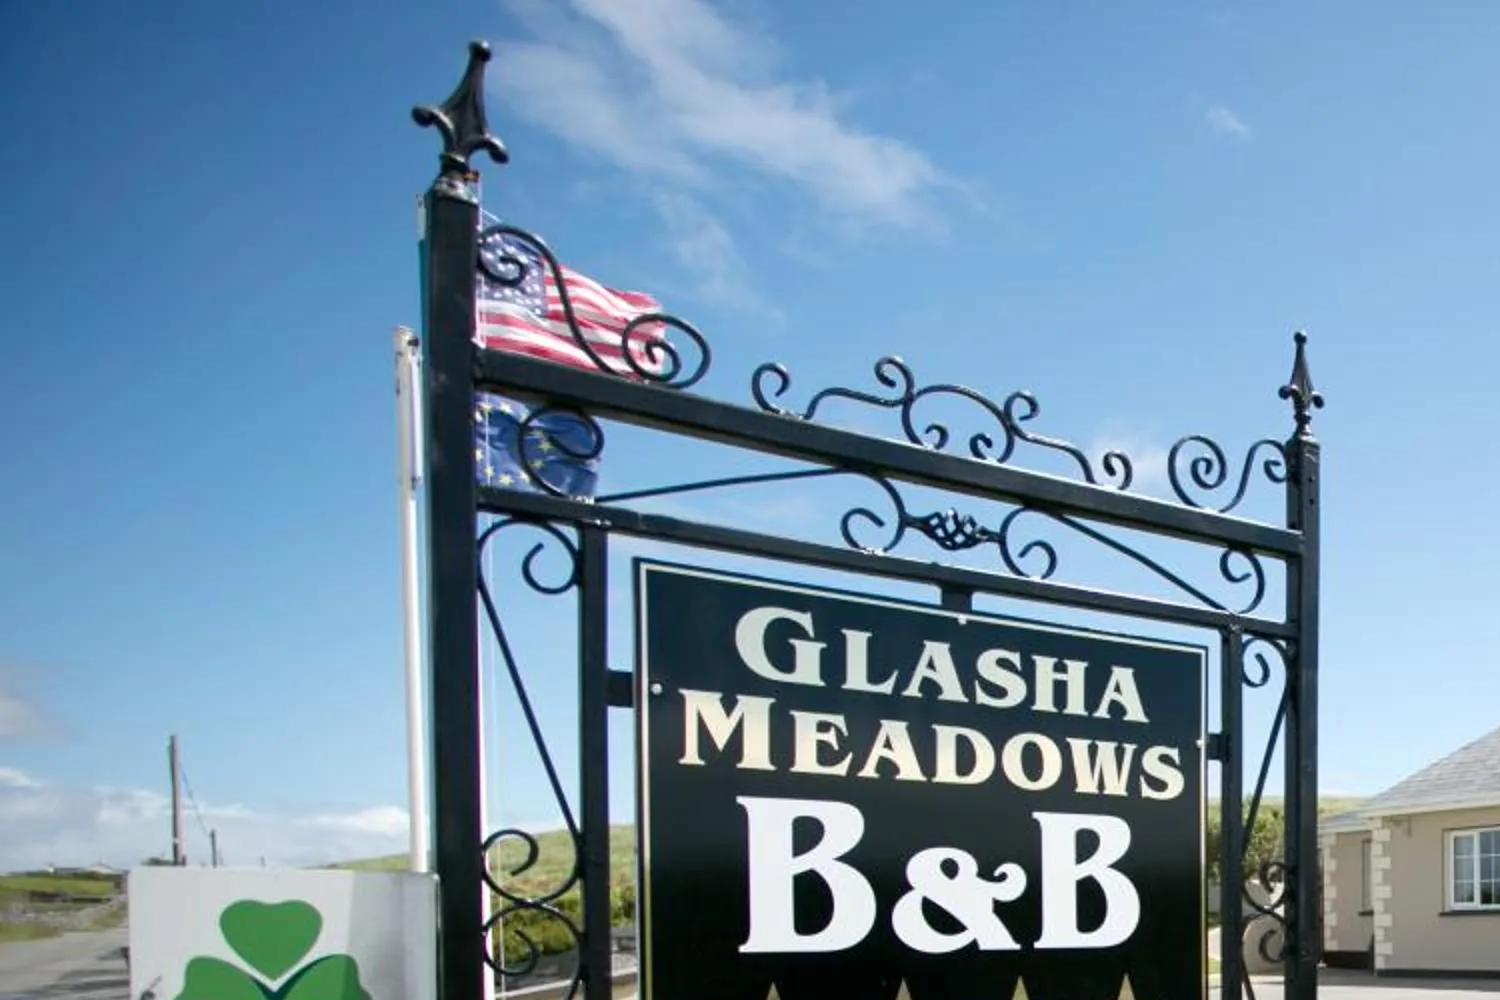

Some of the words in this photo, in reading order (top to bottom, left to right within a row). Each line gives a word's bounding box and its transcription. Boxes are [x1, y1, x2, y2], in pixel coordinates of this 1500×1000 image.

[734, 605, 1148, 724] GLASHA
[678, 688, 1187, 801] MEADOWS
[736, 795, 1143, 954] B&B
